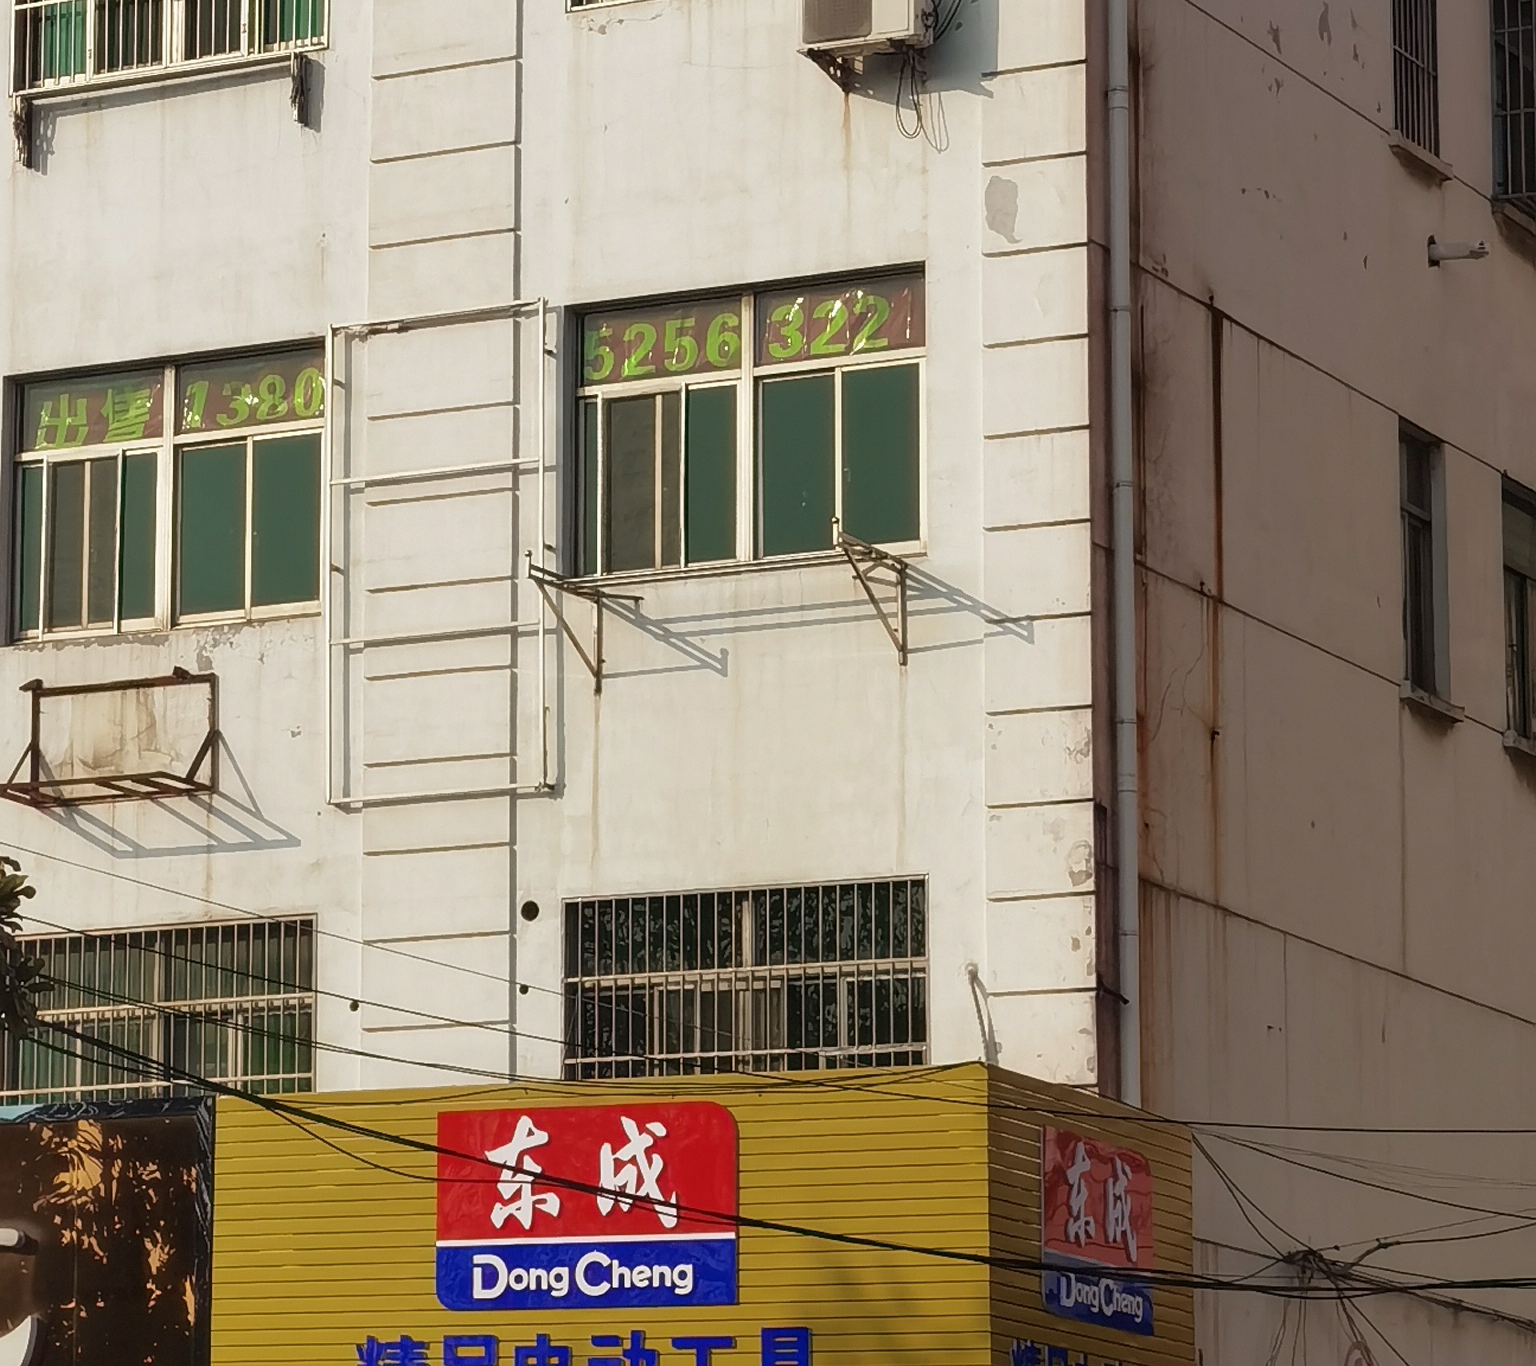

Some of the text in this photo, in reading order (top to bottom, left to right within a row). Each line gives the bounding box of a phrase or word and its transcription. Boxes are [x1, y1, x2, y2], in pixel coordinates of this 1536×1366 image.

[35, 387, 151, 450] 出售
[484, 1115, 678, 1230] 东成
[1066, 1141, 1138, 1263] 东成
[472, 1251, 694, 1300] DongCheng
